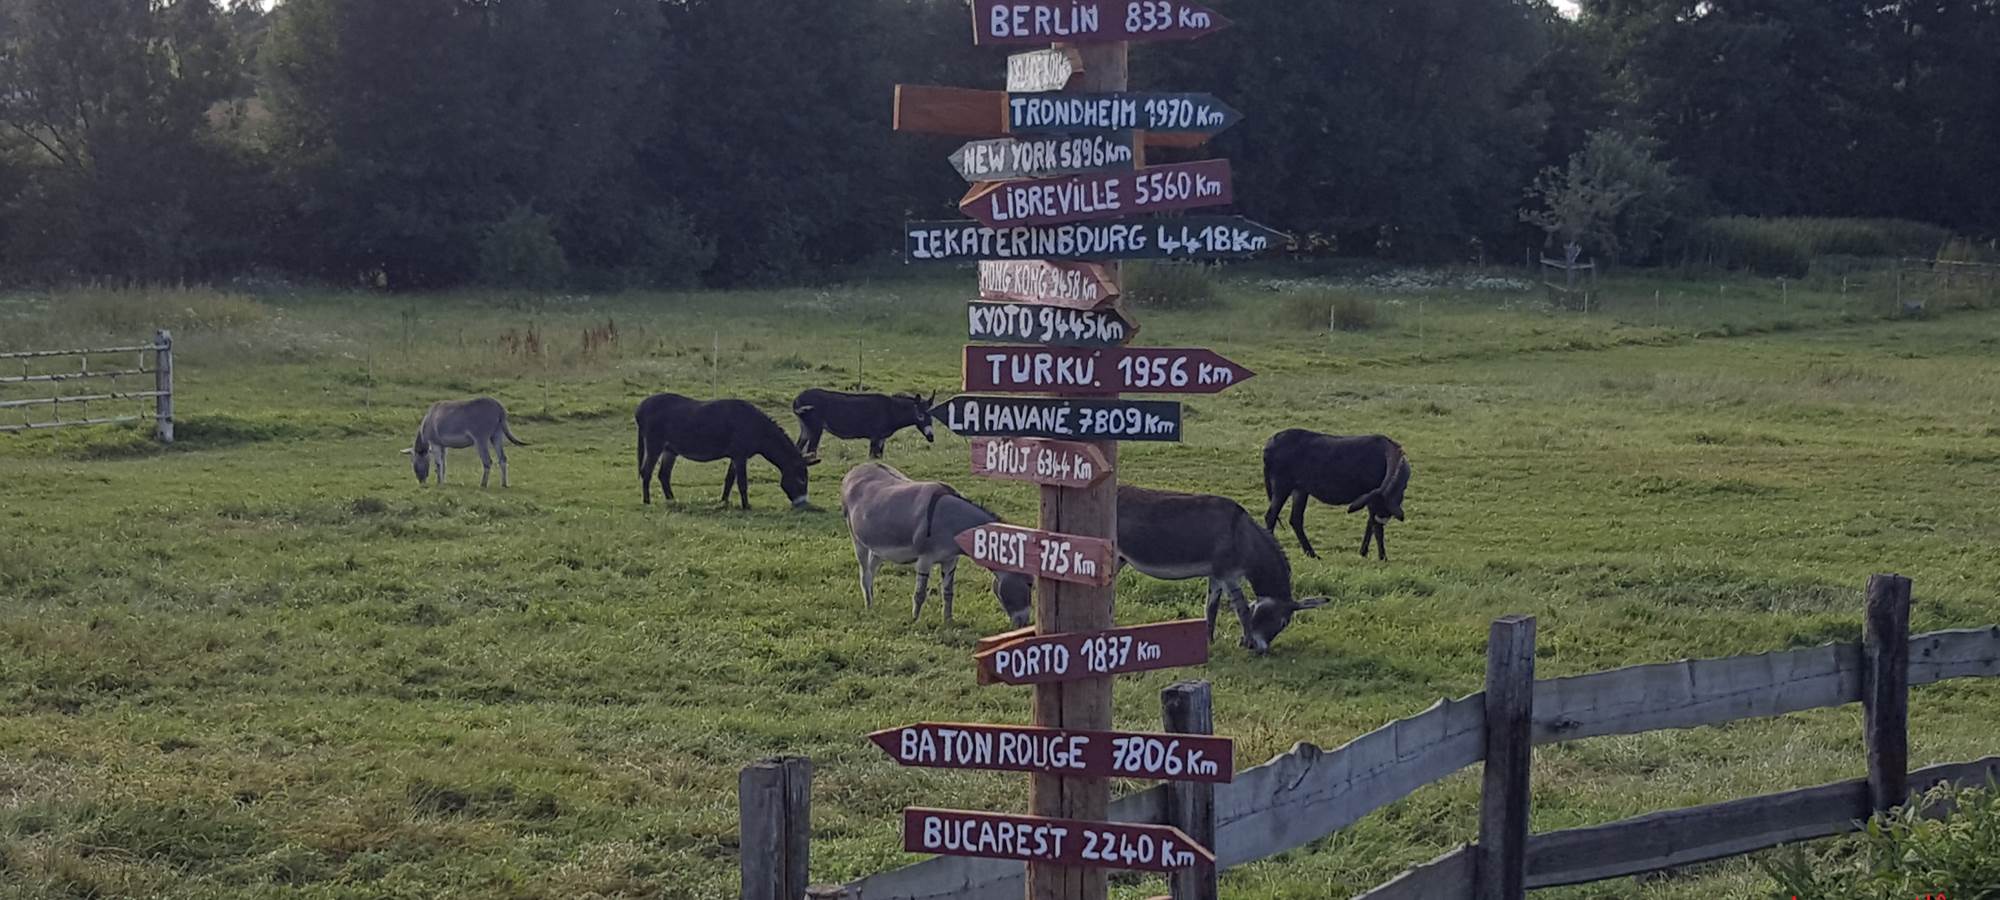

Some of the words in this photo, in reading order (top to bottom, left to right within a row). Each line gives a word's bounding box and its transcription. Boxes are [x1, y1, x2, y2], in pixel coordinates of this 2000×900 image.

[1125, 1, 1172, 31] 833
[1178, 6, 1211, 29] Km
[1145, 98, 1193, 128] 1970
[1196, 104, 1224, 126] Km
[963, 147, 1004, 174] NEW
[1013, 140, 1057, 172] YORK
[1060, 135, 1103, 166] 5896
[1105, 142, 1132, 162] Km
[1135, 170, 1191, 205] 5560
[1195, 175, 1221, 197] Km
[910, 224, 1147, 259] IEKATERINBOURG
[1158, 225, 1229, 252] 4418
[1231, 230, 1267, 251] Km
[980, 262, 1011, 292] HONG
[1014, 265, 1048, 295] KONG
[1051, 266, 1080, 299] 9458
[1082, 278, 1097, 299] Km
[969, 304, 1033, 337] KYOTO
[1040, 308, 1097, 341] 9445
[1097, 313, 1123, 342] Km
[1118, 355, 1188, 387] 1956
[1198, 363, 1233, 384] Km
[948, 401, 980, 431] LA
[1079, 407, 1141, 434] 7809
[1145, 413, 1175, 434] Km
[986, 441, 1031, 472] BHUJ
[1037, 449, 1070, 480] 6344
[1073, 454, 1092, 480] Km
[973, 529, 1027, 568] BREST
[1039, 538, 1069, 574] 775
[1073, 552, 1095, 576] Km
[995, 644, 1069, 678] PORTO
[1080, 635, 1132, 673] 1837
[1137, 642, 1161, 662] Km
[900, 728, 992, 763] BATON
[999, 733, 1089, 769] ROUGE
[1112, 737, 1182, 776] 7806
[1187, 750, 1218, 776] Km
[923, 817, 1067, 858] BUCAREST
[1082, 830, 1154, 864] 2240
[1161, 840, 1194, 867] Km
